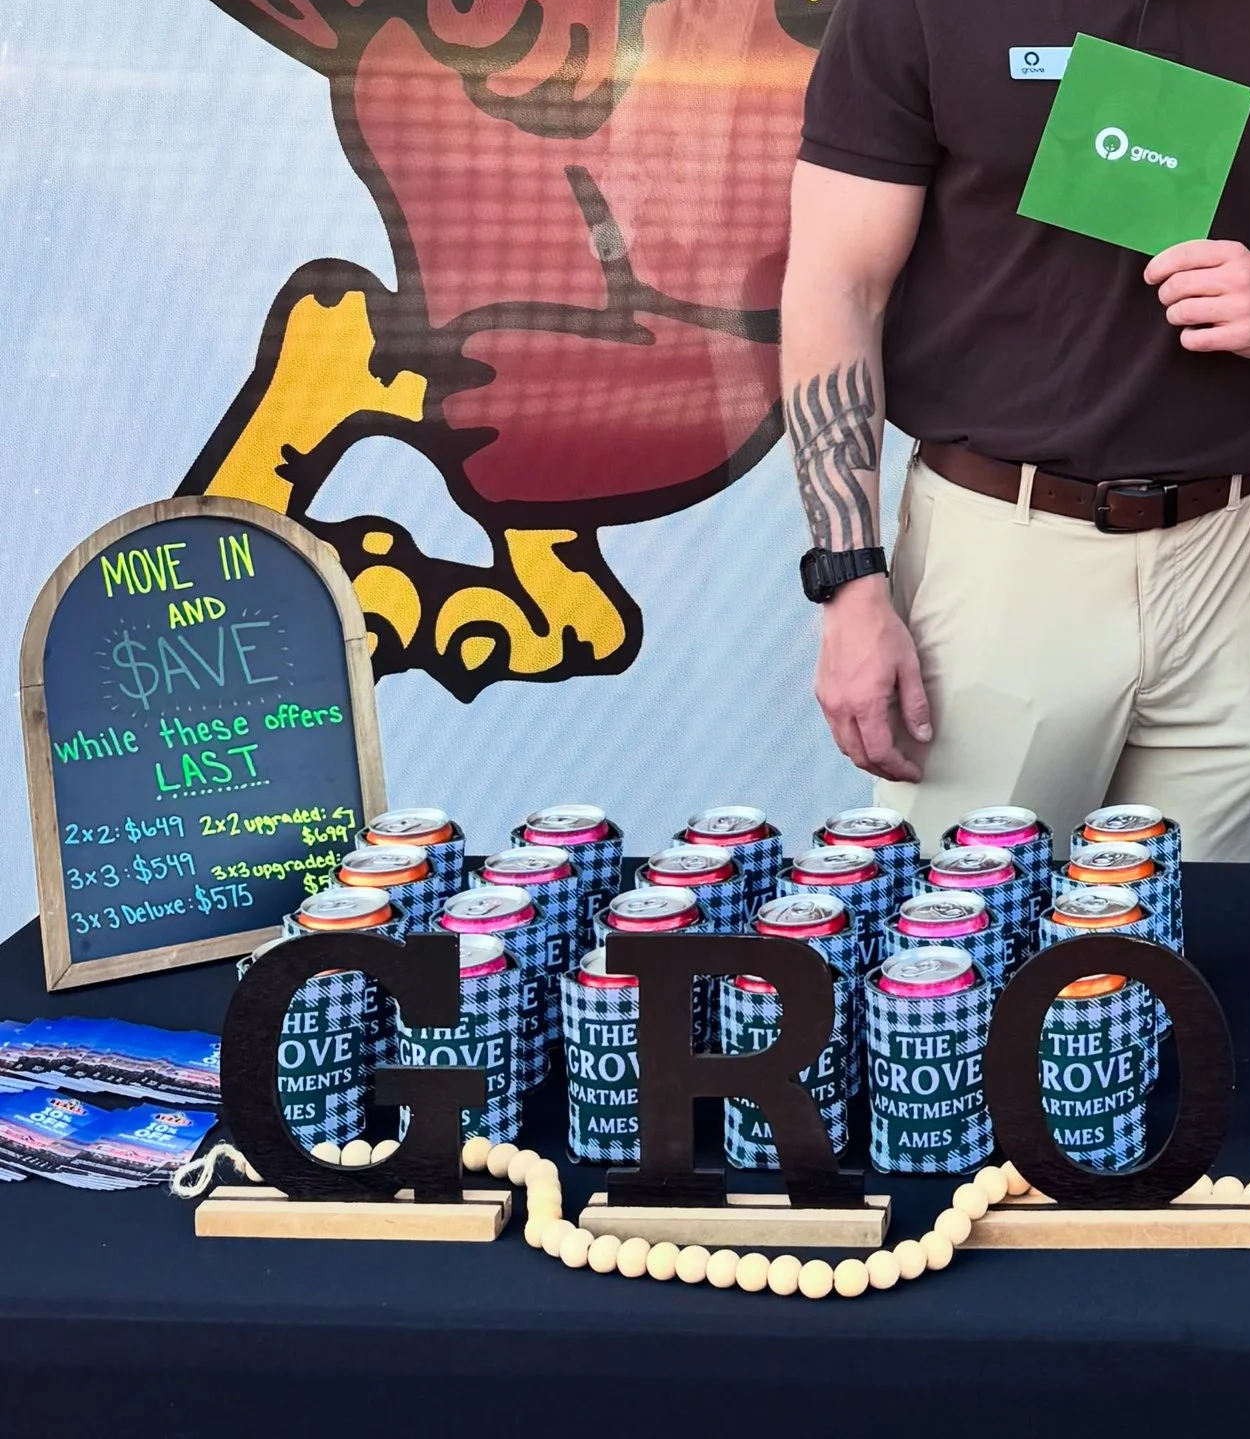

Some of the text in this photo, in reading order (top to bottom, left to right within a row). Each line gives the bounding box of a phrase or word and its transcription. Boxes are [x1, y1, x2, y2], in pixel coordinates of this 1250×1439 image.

[1130, 146, 1178, 169] grove
[101, 532, 256, 598] MOVE IN
[168, 596, 227, 629] AND
[112, 620, 279, 711] $AVE
[160, 711, 249, 749] these
[265, 704, 344, 732] offers
[155, 744, 260, 794] LAST
[124, 816, 184, 843] $649
[244, 807, 327, 835] upgraded:
[302, 824, 348, 846] $699
[133, 852, 196, 884] $549
[252, 850, 341, 880] upgraded:
[121, 897, 194, 925] Deluxe:
[195, 883, 254, 914] $575
[281, 1012, 319, 1033] HE
[585, 1023, 637, 1046] THE
[278, 1033, 352, 1069] OVE
[748, 1027, 781, 1050] TH
[896, 1035, 951, 1059] THE
[1048, 1032, 1103, 1056] THE
[400, 1037, 504, 1069] GROVE
[278, 1067, 352, 1092] TMENTS
[875, 1054, 982, 1095] GROVE
[1042, 1051, 1133, 1093] ROVE
[570, 1080, 638, 1105] APARTME
[875, 1090, 983, 1119] APARTMENTS
[1042, 1087, 1134, 1117] ARTMENTS
[588, 1116, 639, 1133] AMES
[899, 1129, 952, 1148] AMES
[1053, 1127, 1104, 1145] AMES
